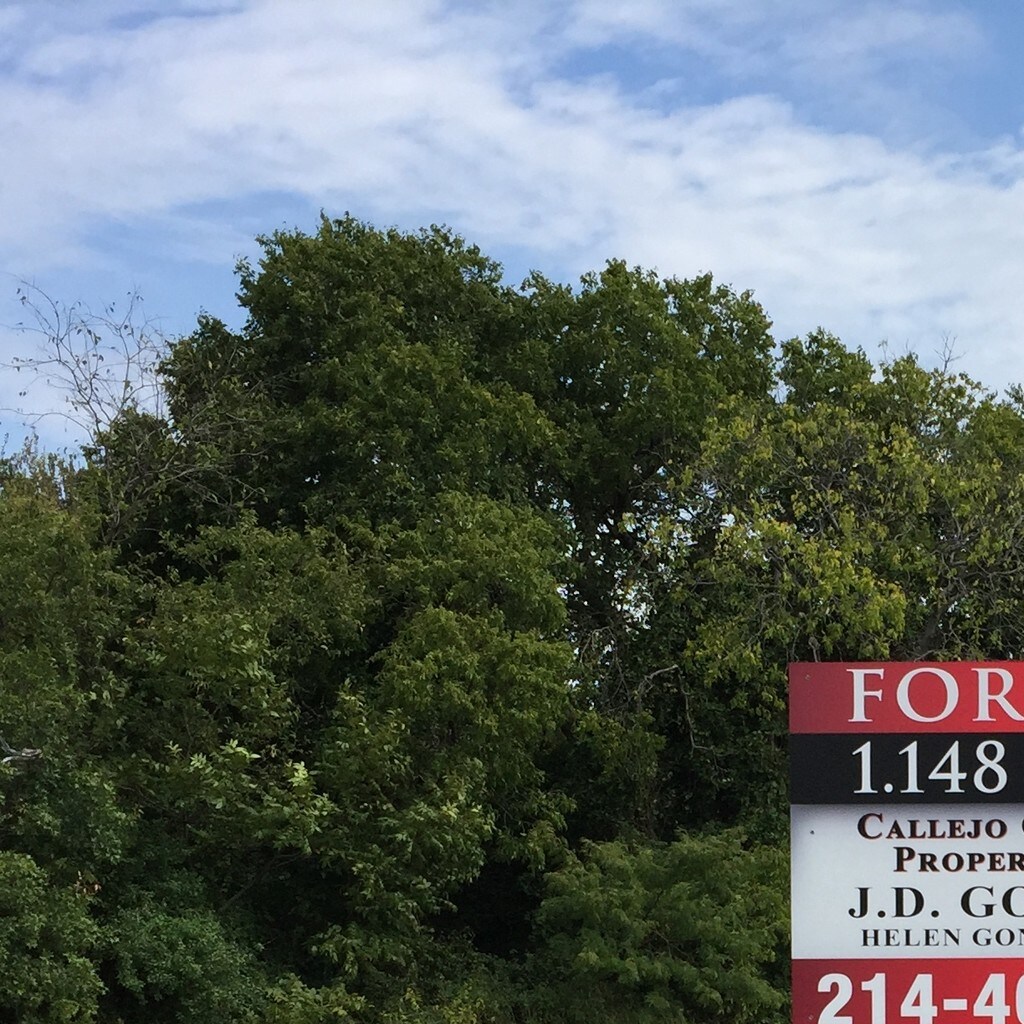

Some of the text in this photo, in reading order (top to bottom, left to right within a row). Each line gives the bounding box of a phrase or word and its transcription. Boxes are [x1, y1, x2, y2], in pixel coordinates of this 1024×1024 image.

[851, 739, 1008, 794] 1.148
[857, 812, 1008, 839] CALLEJO
[848, 886, 940, 919] J.D.
[861, 928, 961, 947] HELEN
